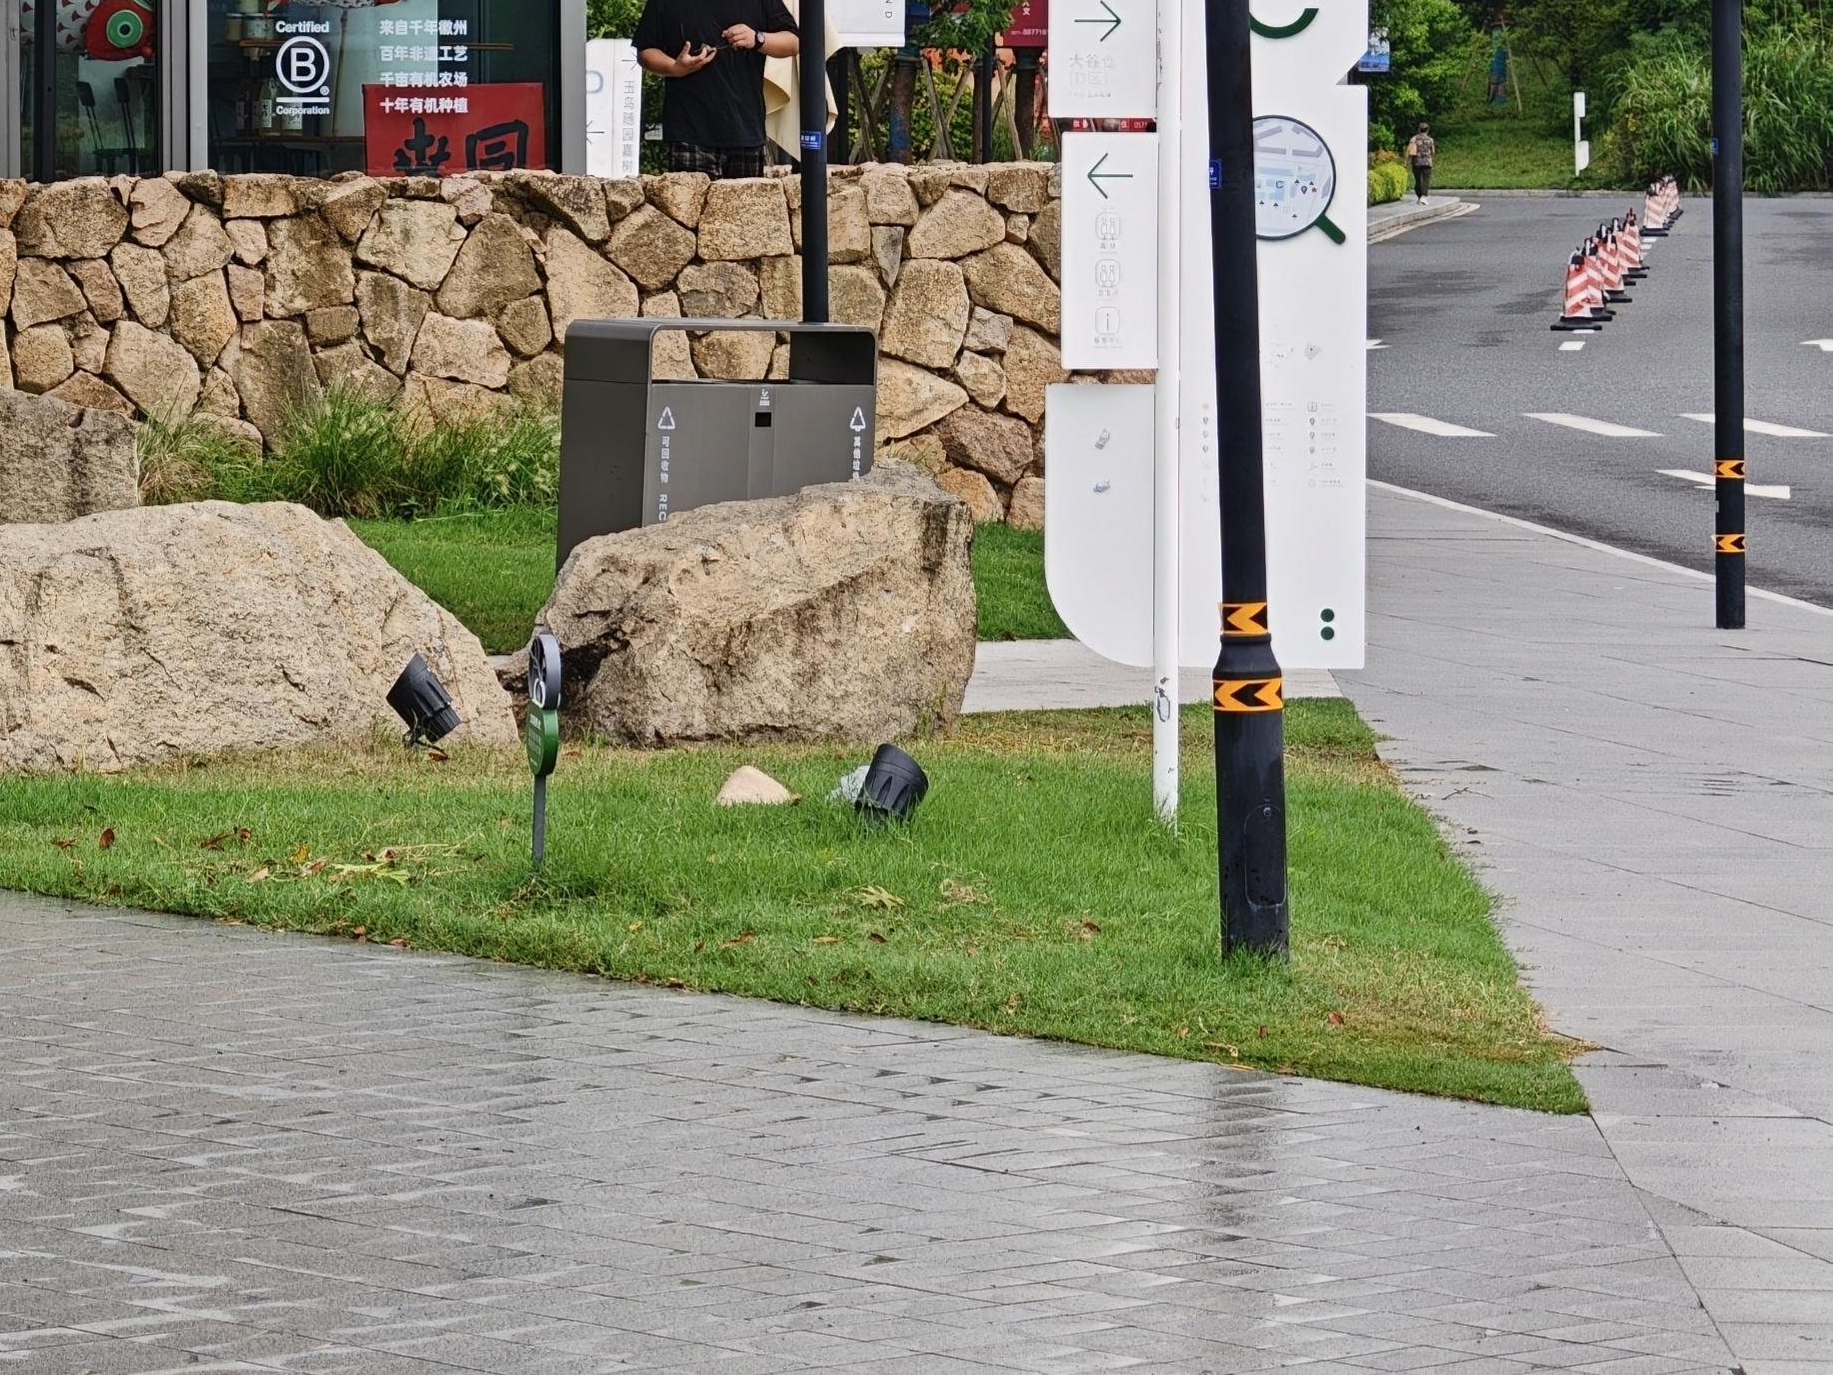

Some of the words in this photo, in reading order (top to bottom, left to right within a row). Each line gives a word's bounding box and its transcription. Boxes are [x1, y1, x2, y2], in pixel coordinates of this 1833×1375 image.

[275, 20, 330, 33] Certified
[379, 19, 467, 36] 来自千年徽州
[379, 45, 468, 62] 百年非遗工艺
[379, 71, 468, 88] 千亩有机农场
[275, 105, 330, 115] Corporation
[379, 97, 468, 114] 十年有机种植
